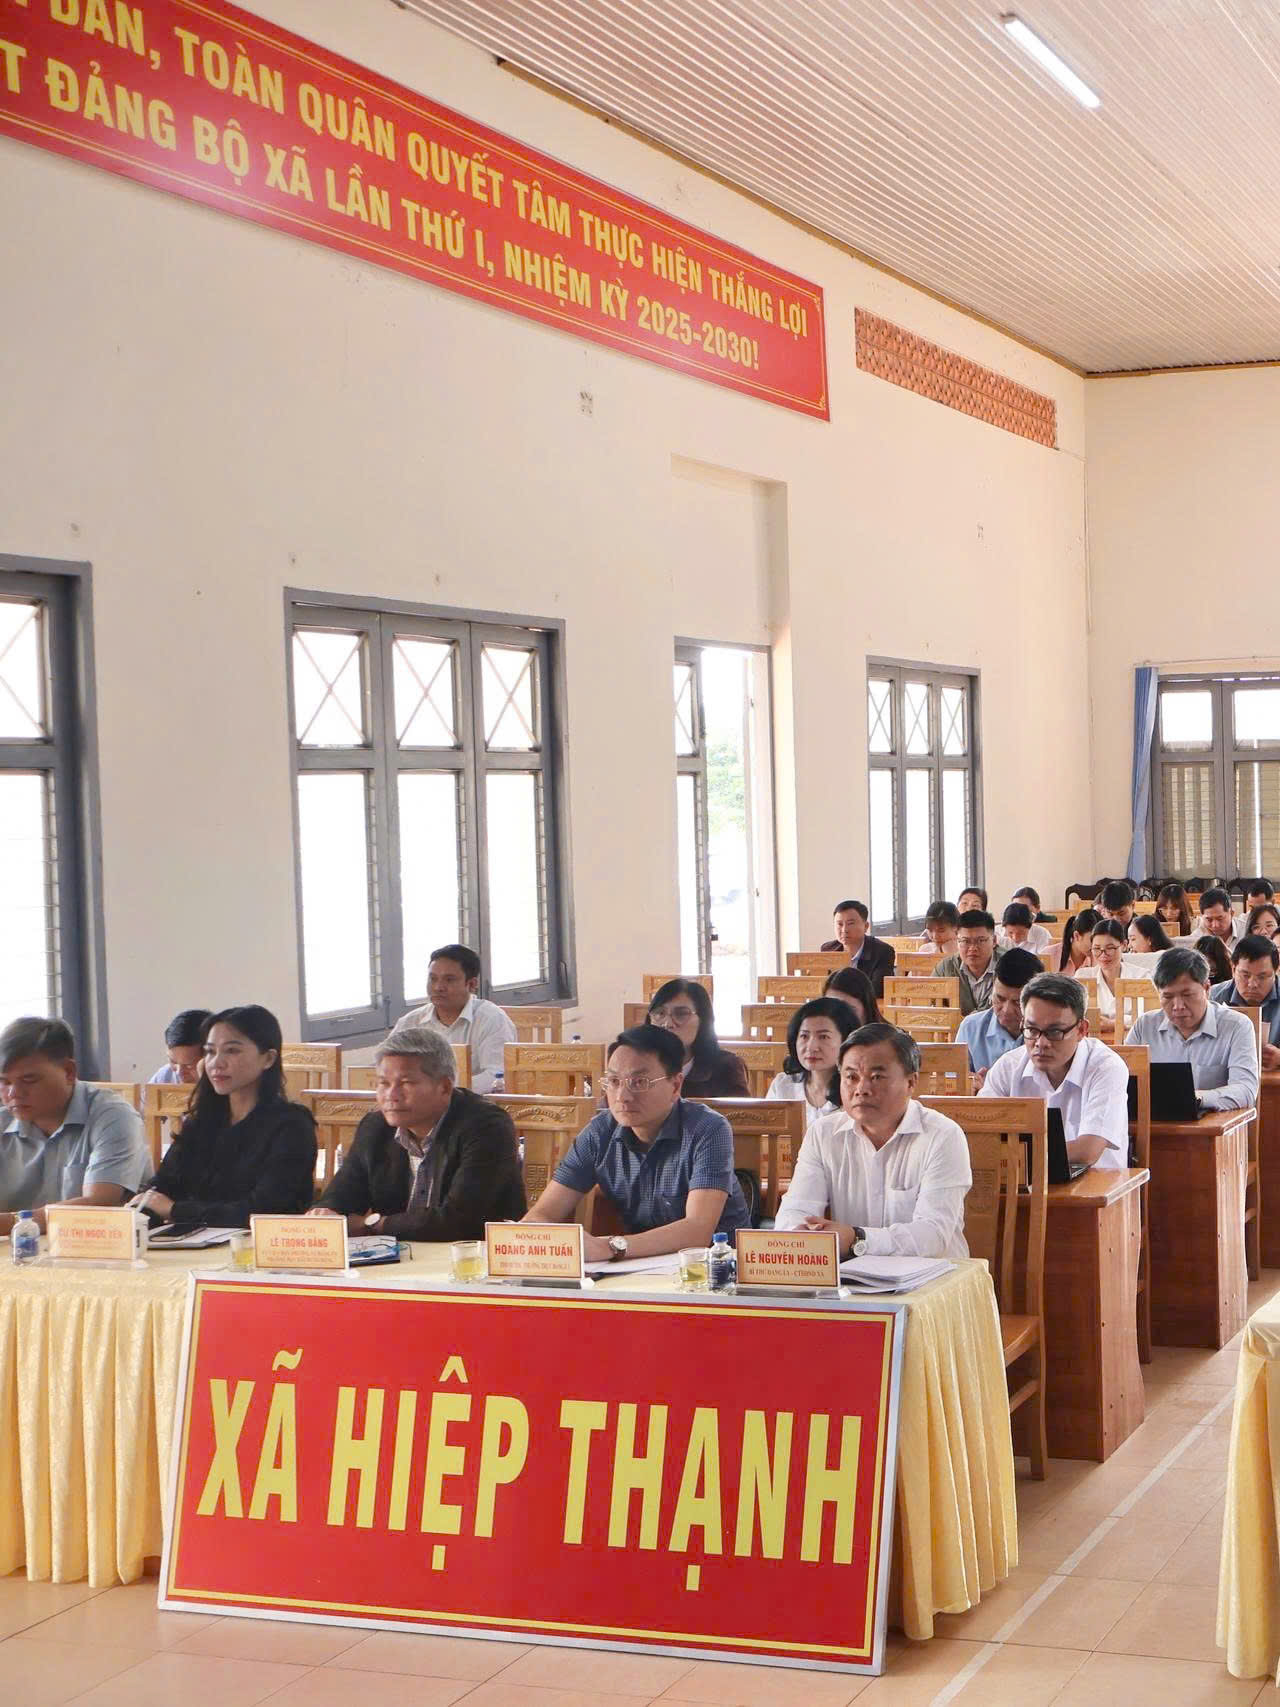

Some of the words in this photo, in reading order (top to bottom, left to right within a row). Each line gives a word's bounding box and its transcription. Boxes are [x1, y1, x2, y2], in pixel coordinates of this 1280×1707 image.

[44, 57, 177, 152] ĐẢNG
[192, 115, 250, 186] BỘ
[263, 142, 314, 202] XÃ
[325, 162, 392, 231] LẦN
[401, 199, 467, 259] THỨ
[475, 229, 495, 277] I,
[503, 241, 592, 309] NHIỆM
[599, 277, 630, 322] KỲ
[636, 296, 760, 371] 2025-2030!
[174, 26, 285, 115] TOÀN
[298, 83, 396, 161] QUÂN
[407, 131, 504, 208] QUYẾT
[512, 180, 572, 239] TÂM
[578, 209, 644, 270] THỰC
[651, 242, 703, 295] HIỆN
[708, 268, 774, 328] THẮNG
[779, 295, 808, 341] LỢI
[494, 1242, 526, 1256] HOÀNG
[528, 1245, 547, 1256] ANH
[549, 1242, 573, 1257] TUẤN
[745, 1250, 756, 1264] LÊ
[797, 1252, 829, 1266] HOÀNG
[196, 1348, 304, 1523] XÃ
[326, 1355, 530, 1571] HIỆP
[558, 1399, 862, 1592] THẠNH
